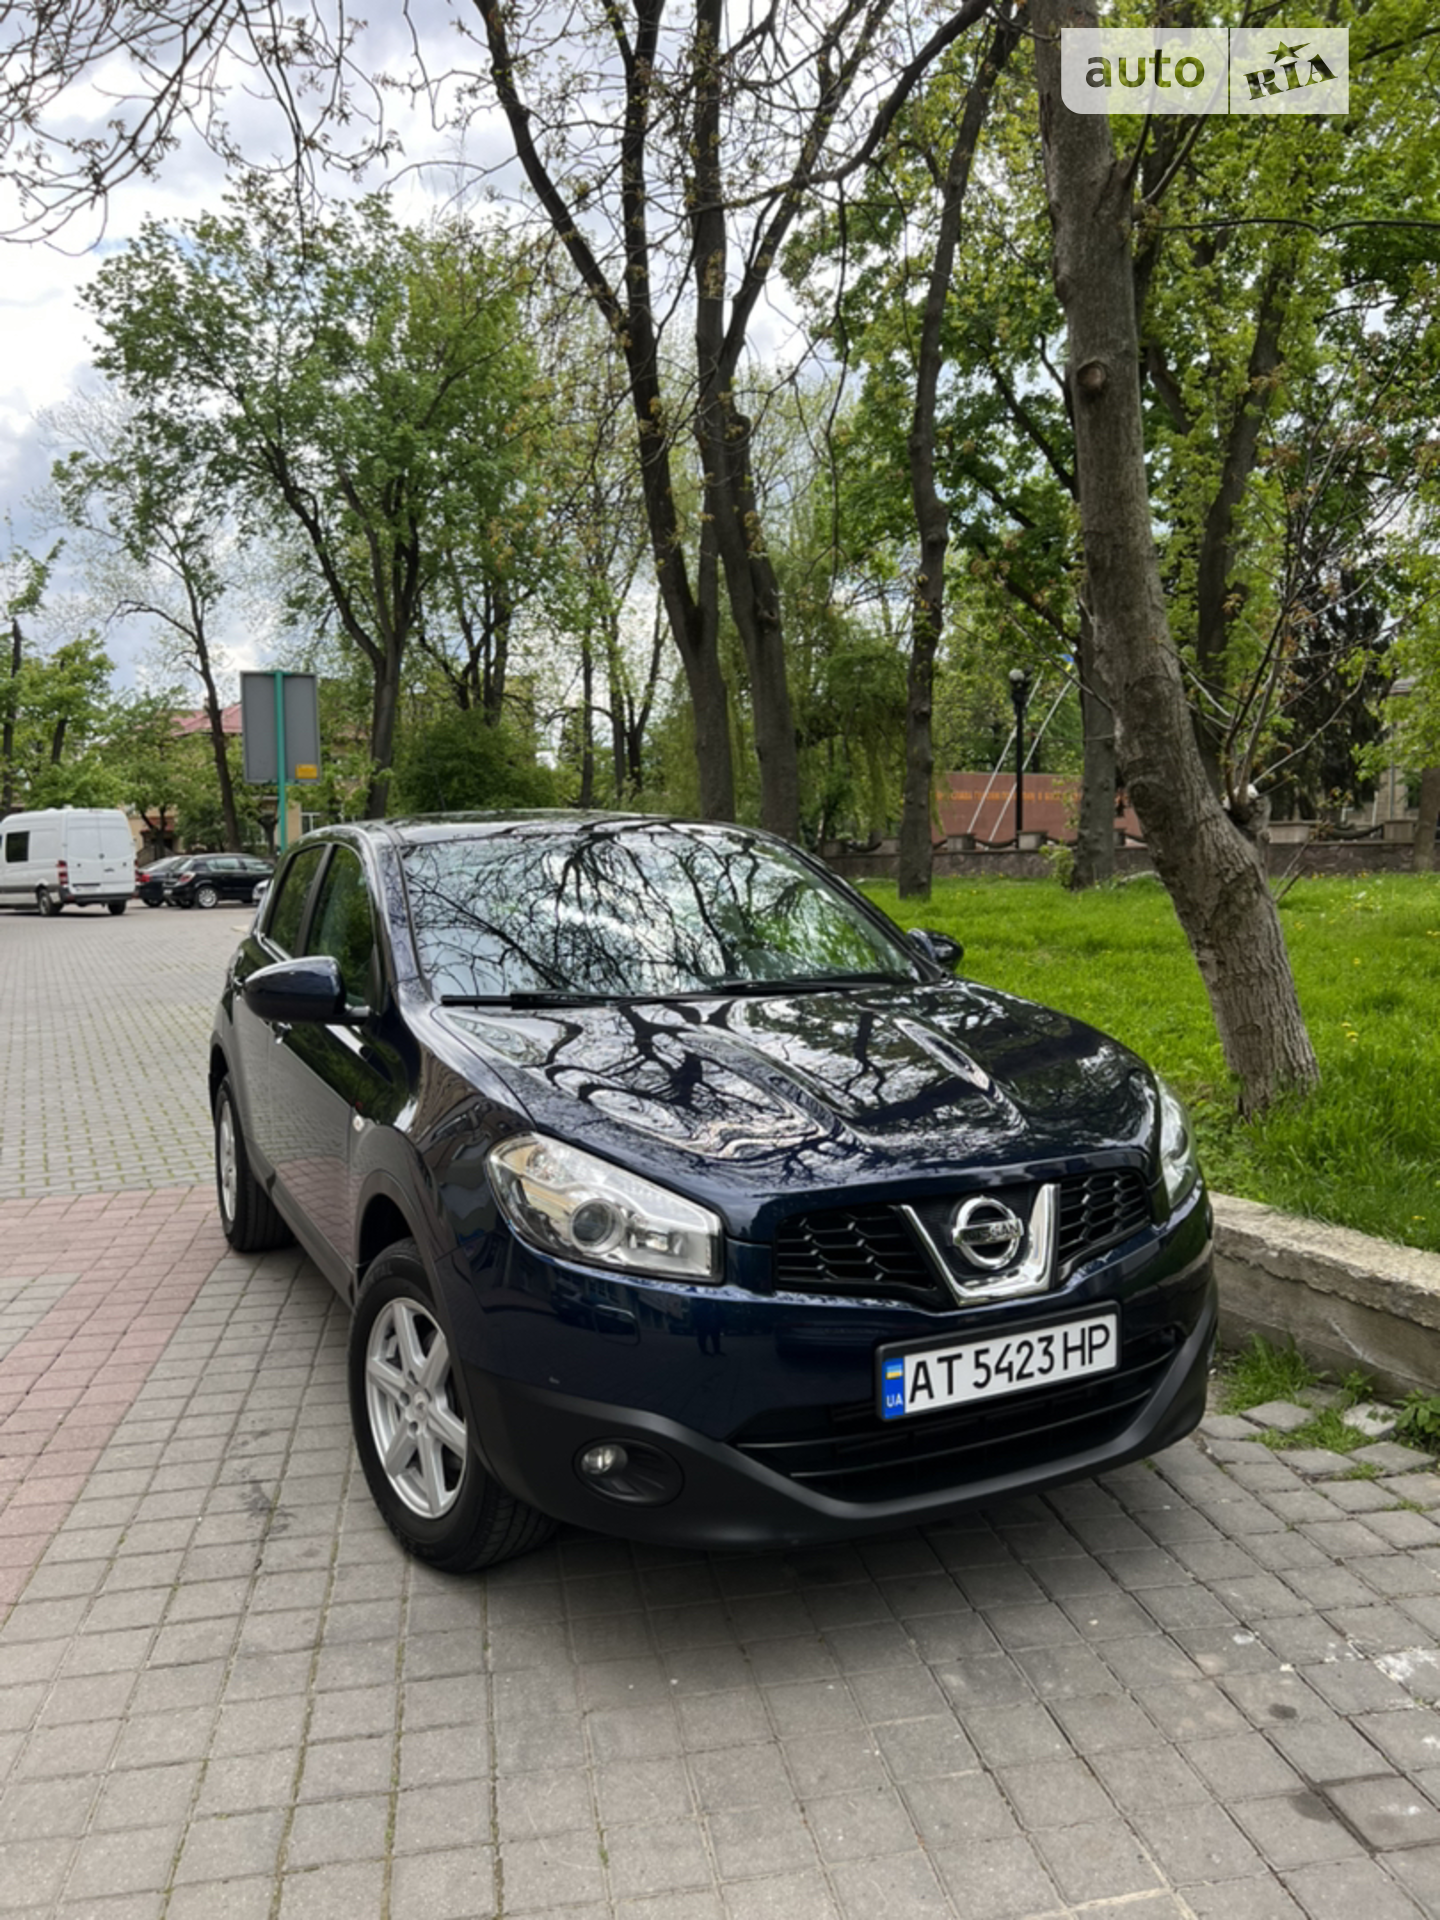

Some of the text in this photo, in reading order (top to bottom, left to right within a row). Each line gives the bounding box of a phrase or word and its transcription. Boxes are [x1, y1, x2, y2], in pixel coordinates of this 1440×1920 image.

[908, 1323, 1110, 1404] AT 5423 HP
[886, 1394, 903, 1408] UA
